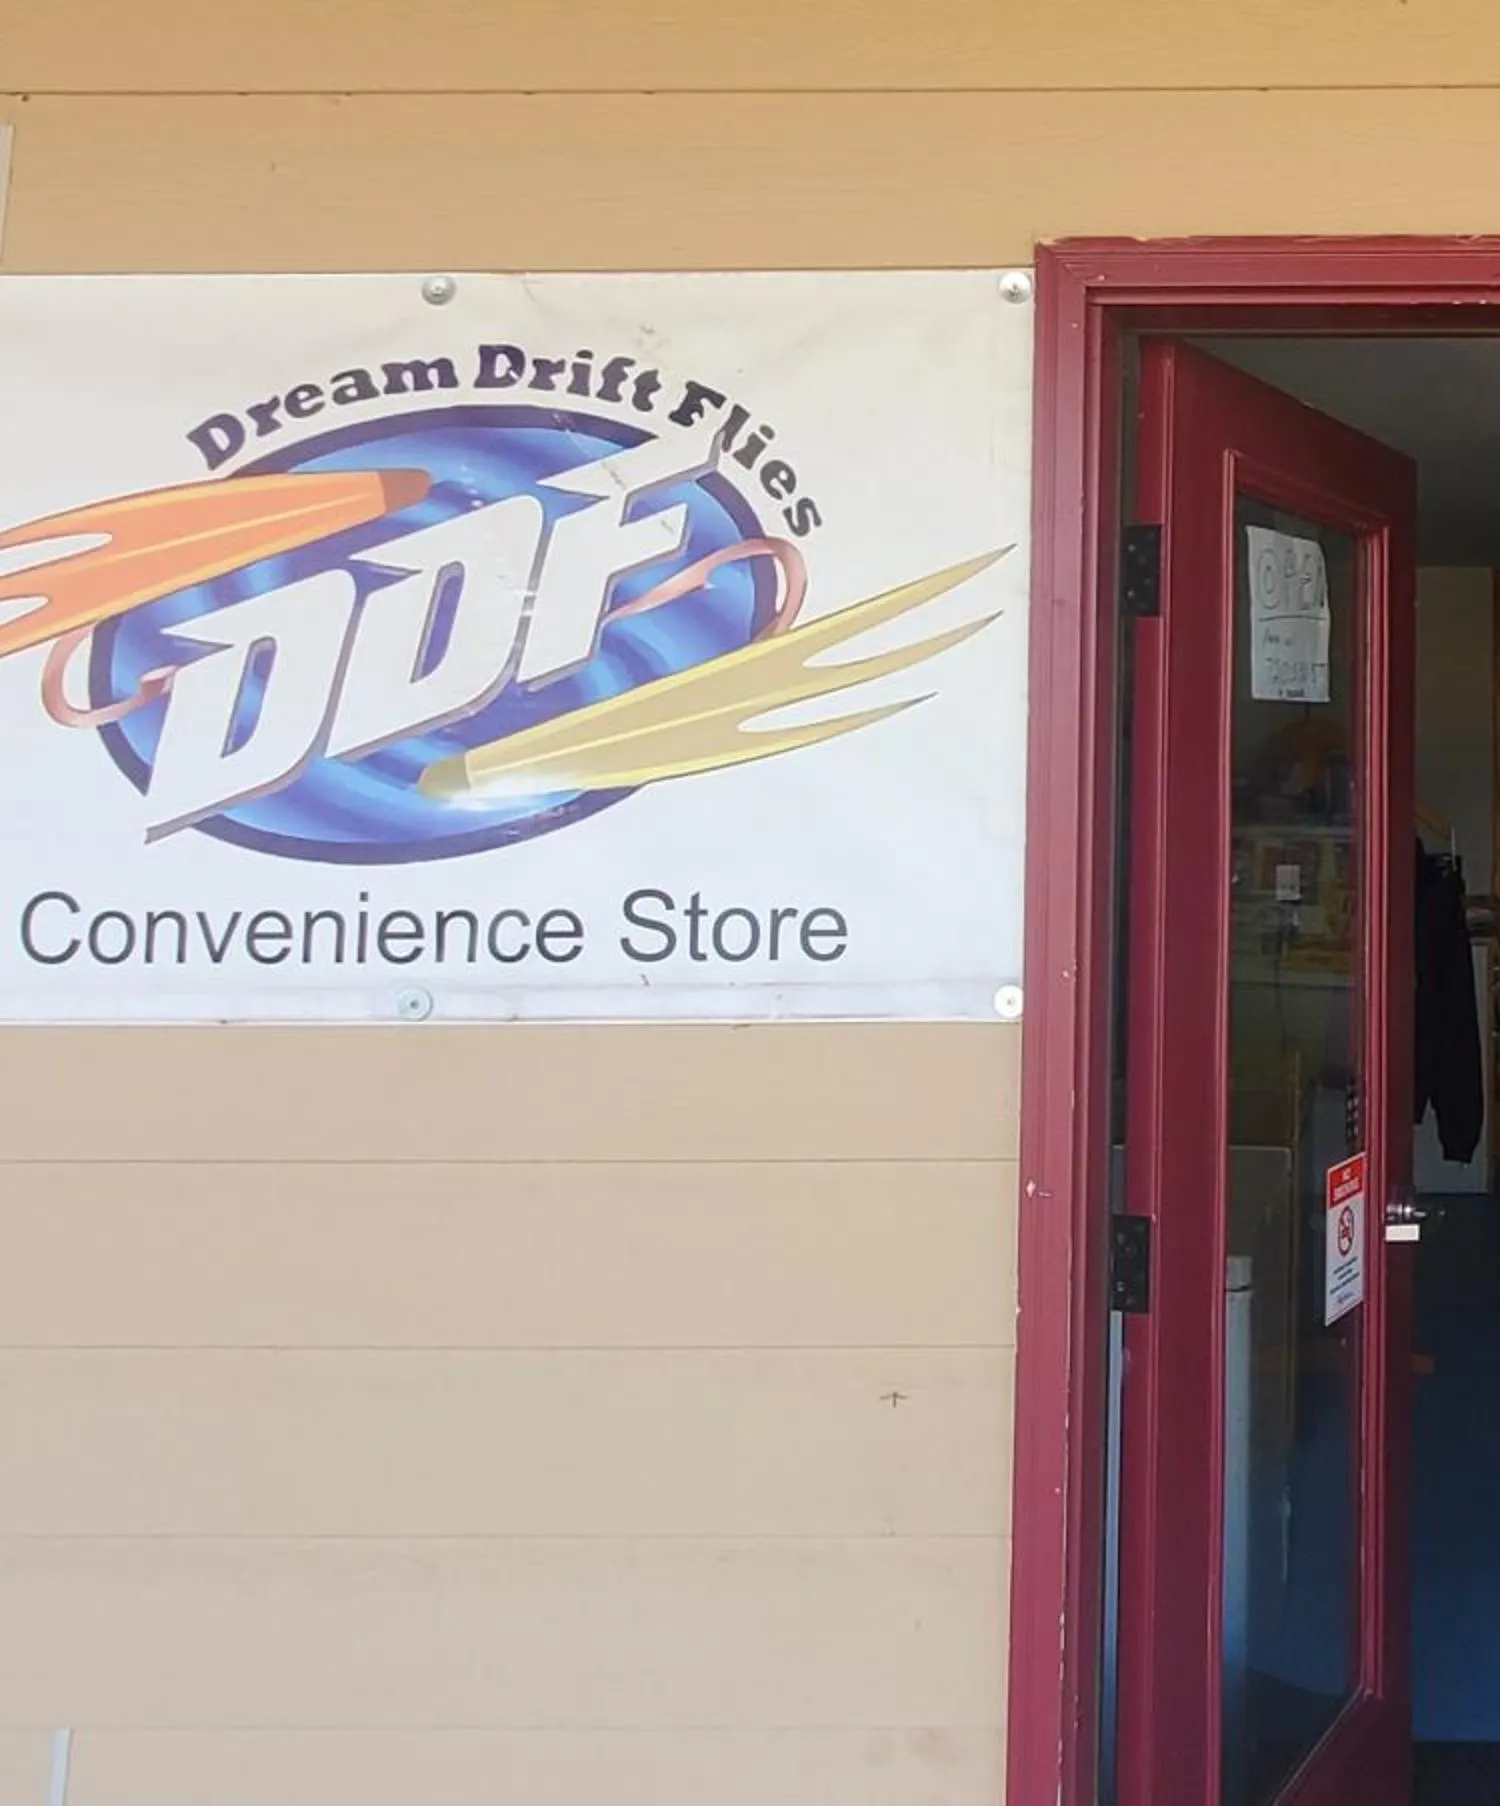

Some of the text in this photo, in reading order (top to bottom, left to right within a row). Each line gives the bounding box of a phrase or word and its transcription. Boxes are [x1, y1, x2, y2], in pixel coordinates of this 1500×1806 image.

[186, 343, 823, 538] Dream Drift Flies
[145, 427, 724, 842] DDF
[20, 889, 849, 965] Convenience Store
